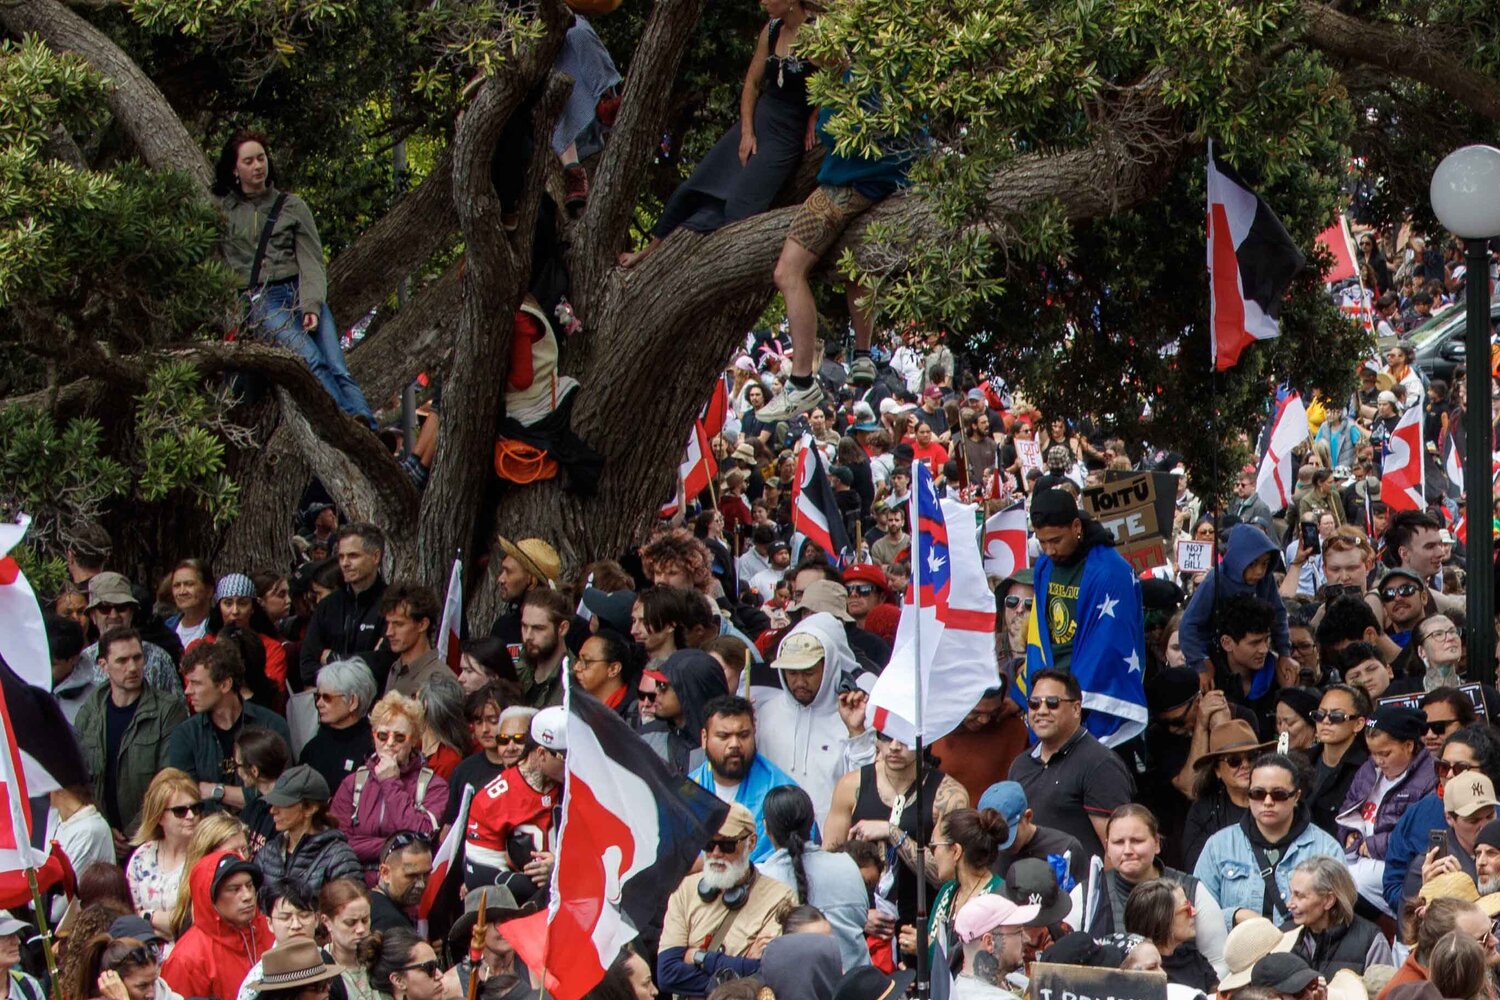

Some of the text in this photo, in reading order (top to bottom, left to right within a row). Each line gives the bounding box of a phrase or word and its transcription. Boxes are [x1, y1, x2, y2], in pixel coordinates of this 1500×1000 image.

[1085, 477, 1157, 511] TOITŪ
[1104, 514, 1145, 540] TE
[1187, 544, 1204, 552] NOT
[1189, 553, 1201, 561] MY
[1184, 560, 1203, 569] BILL
